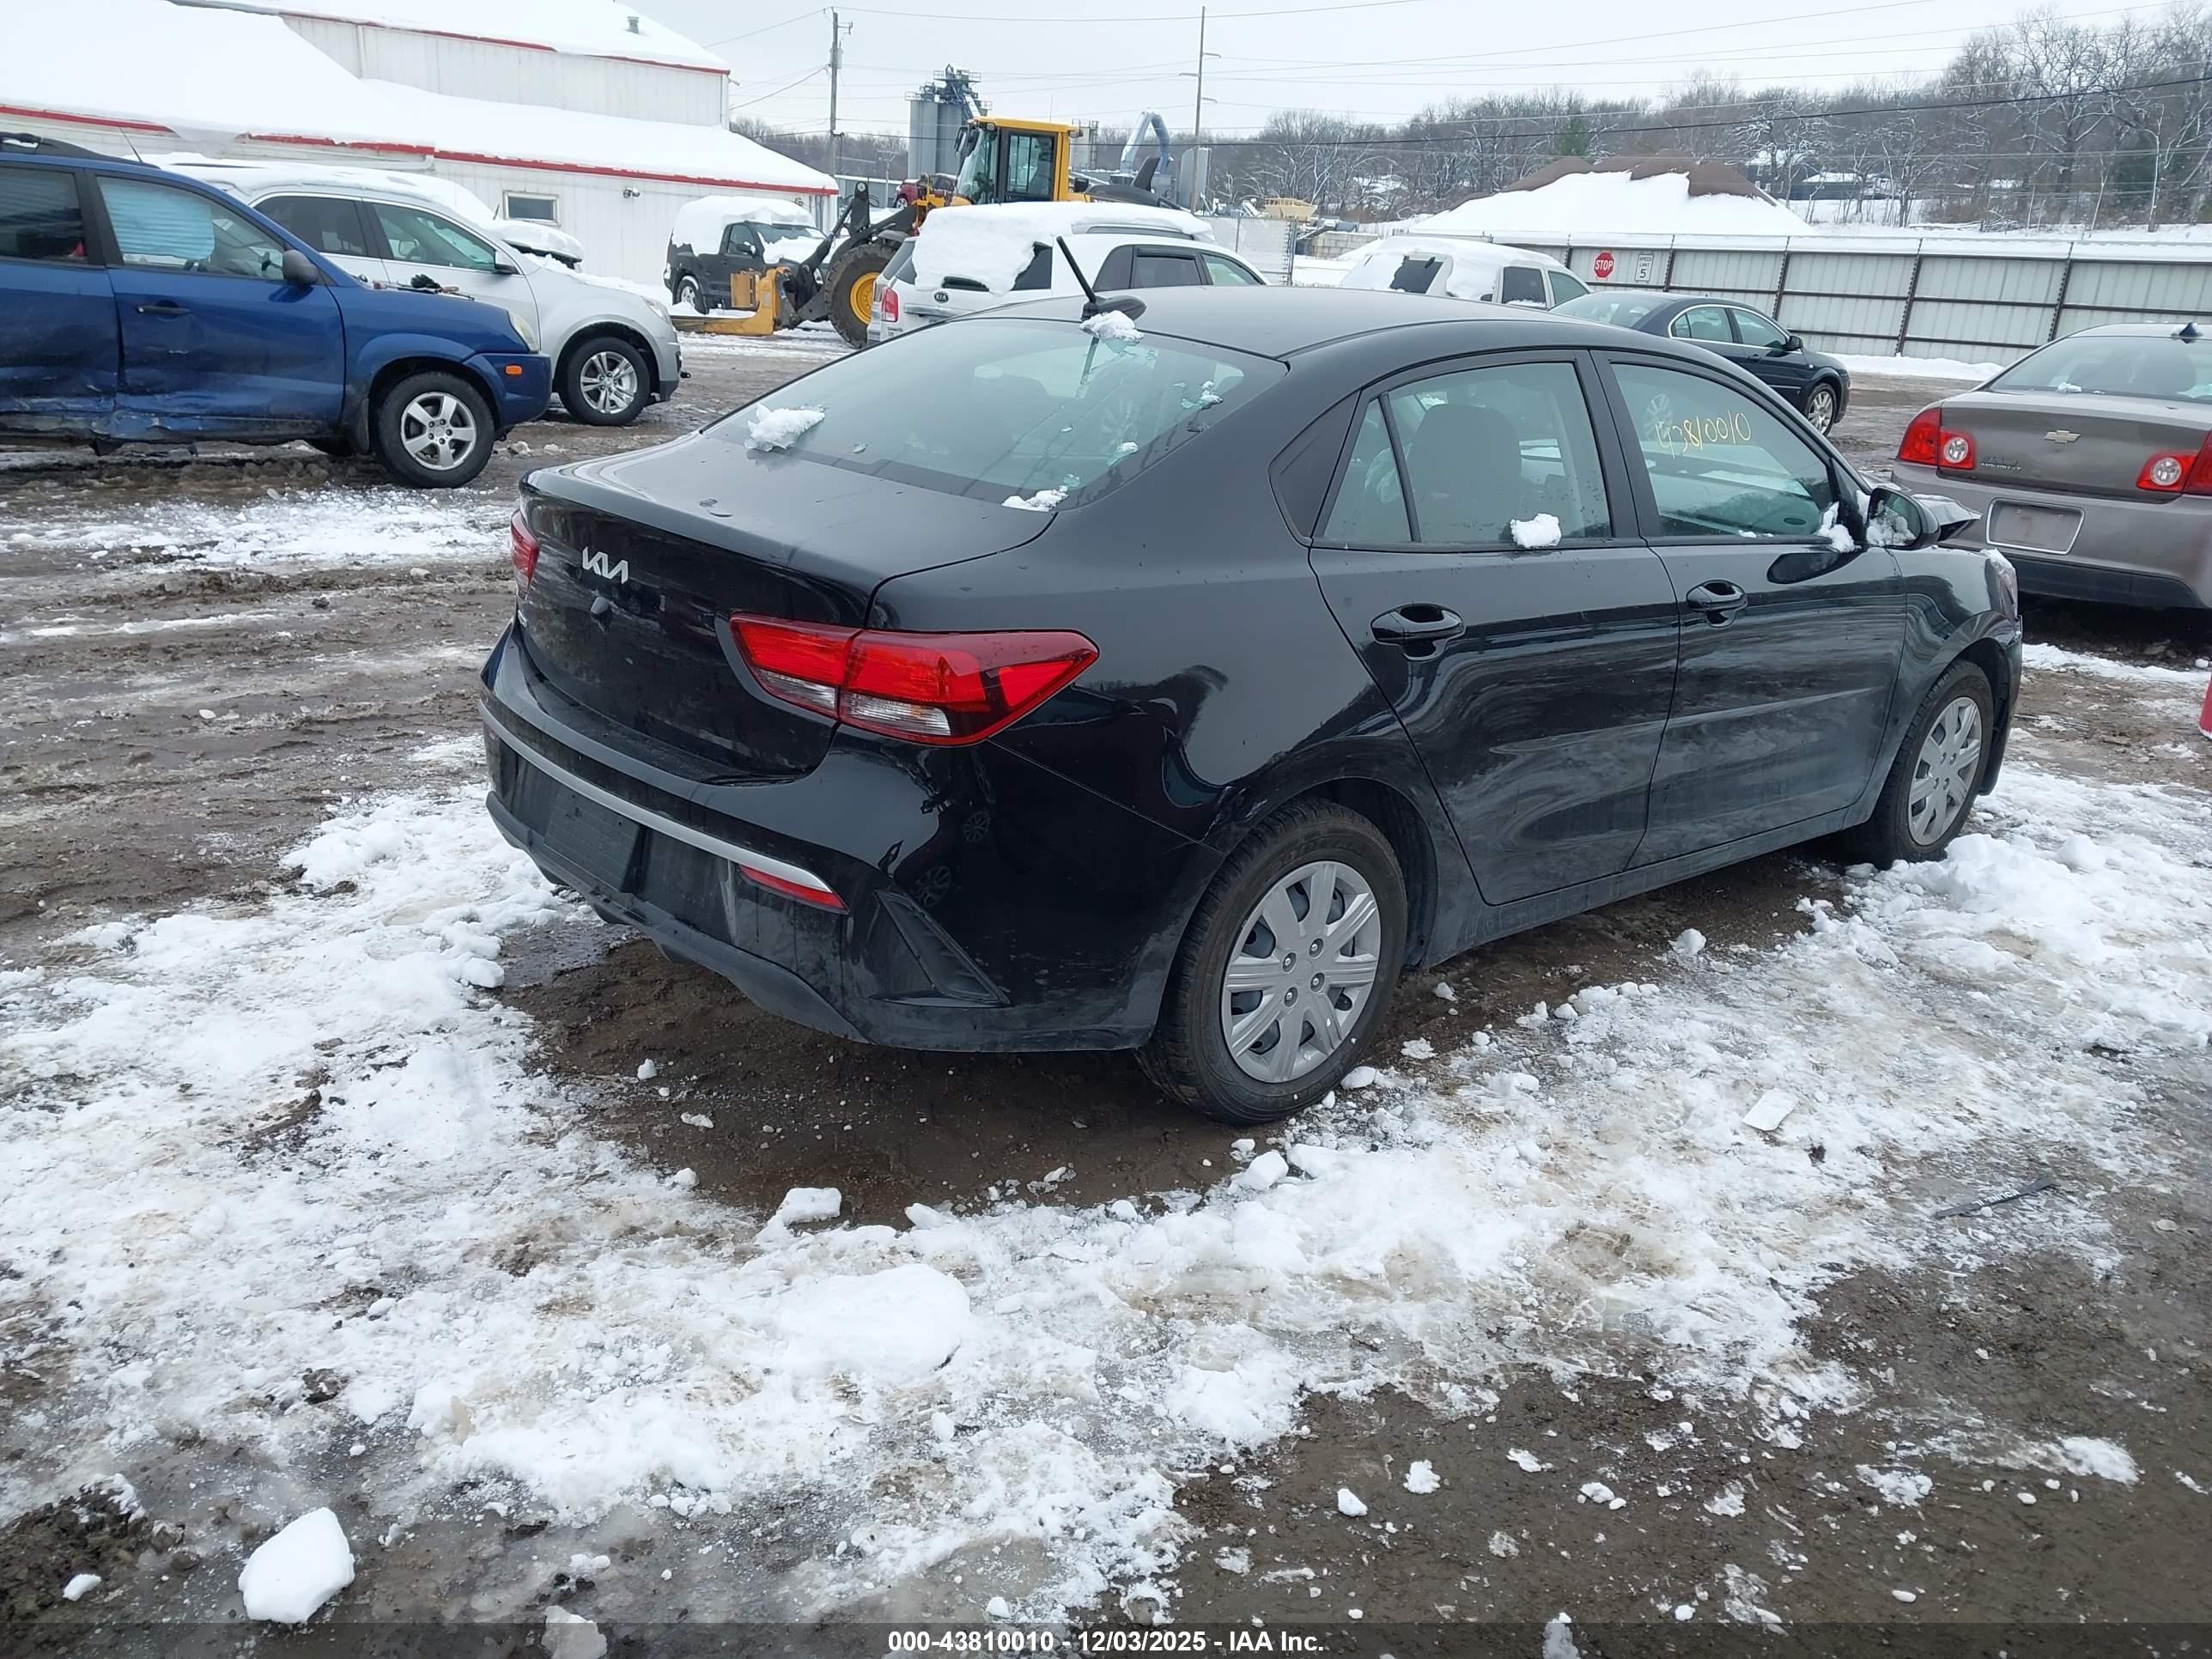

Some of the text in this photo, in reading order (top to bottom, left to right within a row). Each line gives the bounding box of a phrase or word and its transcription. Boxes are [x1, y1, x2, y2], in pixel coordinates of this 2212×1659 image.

[1595, 260, 1613, 270] STOP
[1639, 269, 1647, 278] 5
[935, 293, 947, 301] KIA
[582, 546, 629, 585] KIA
